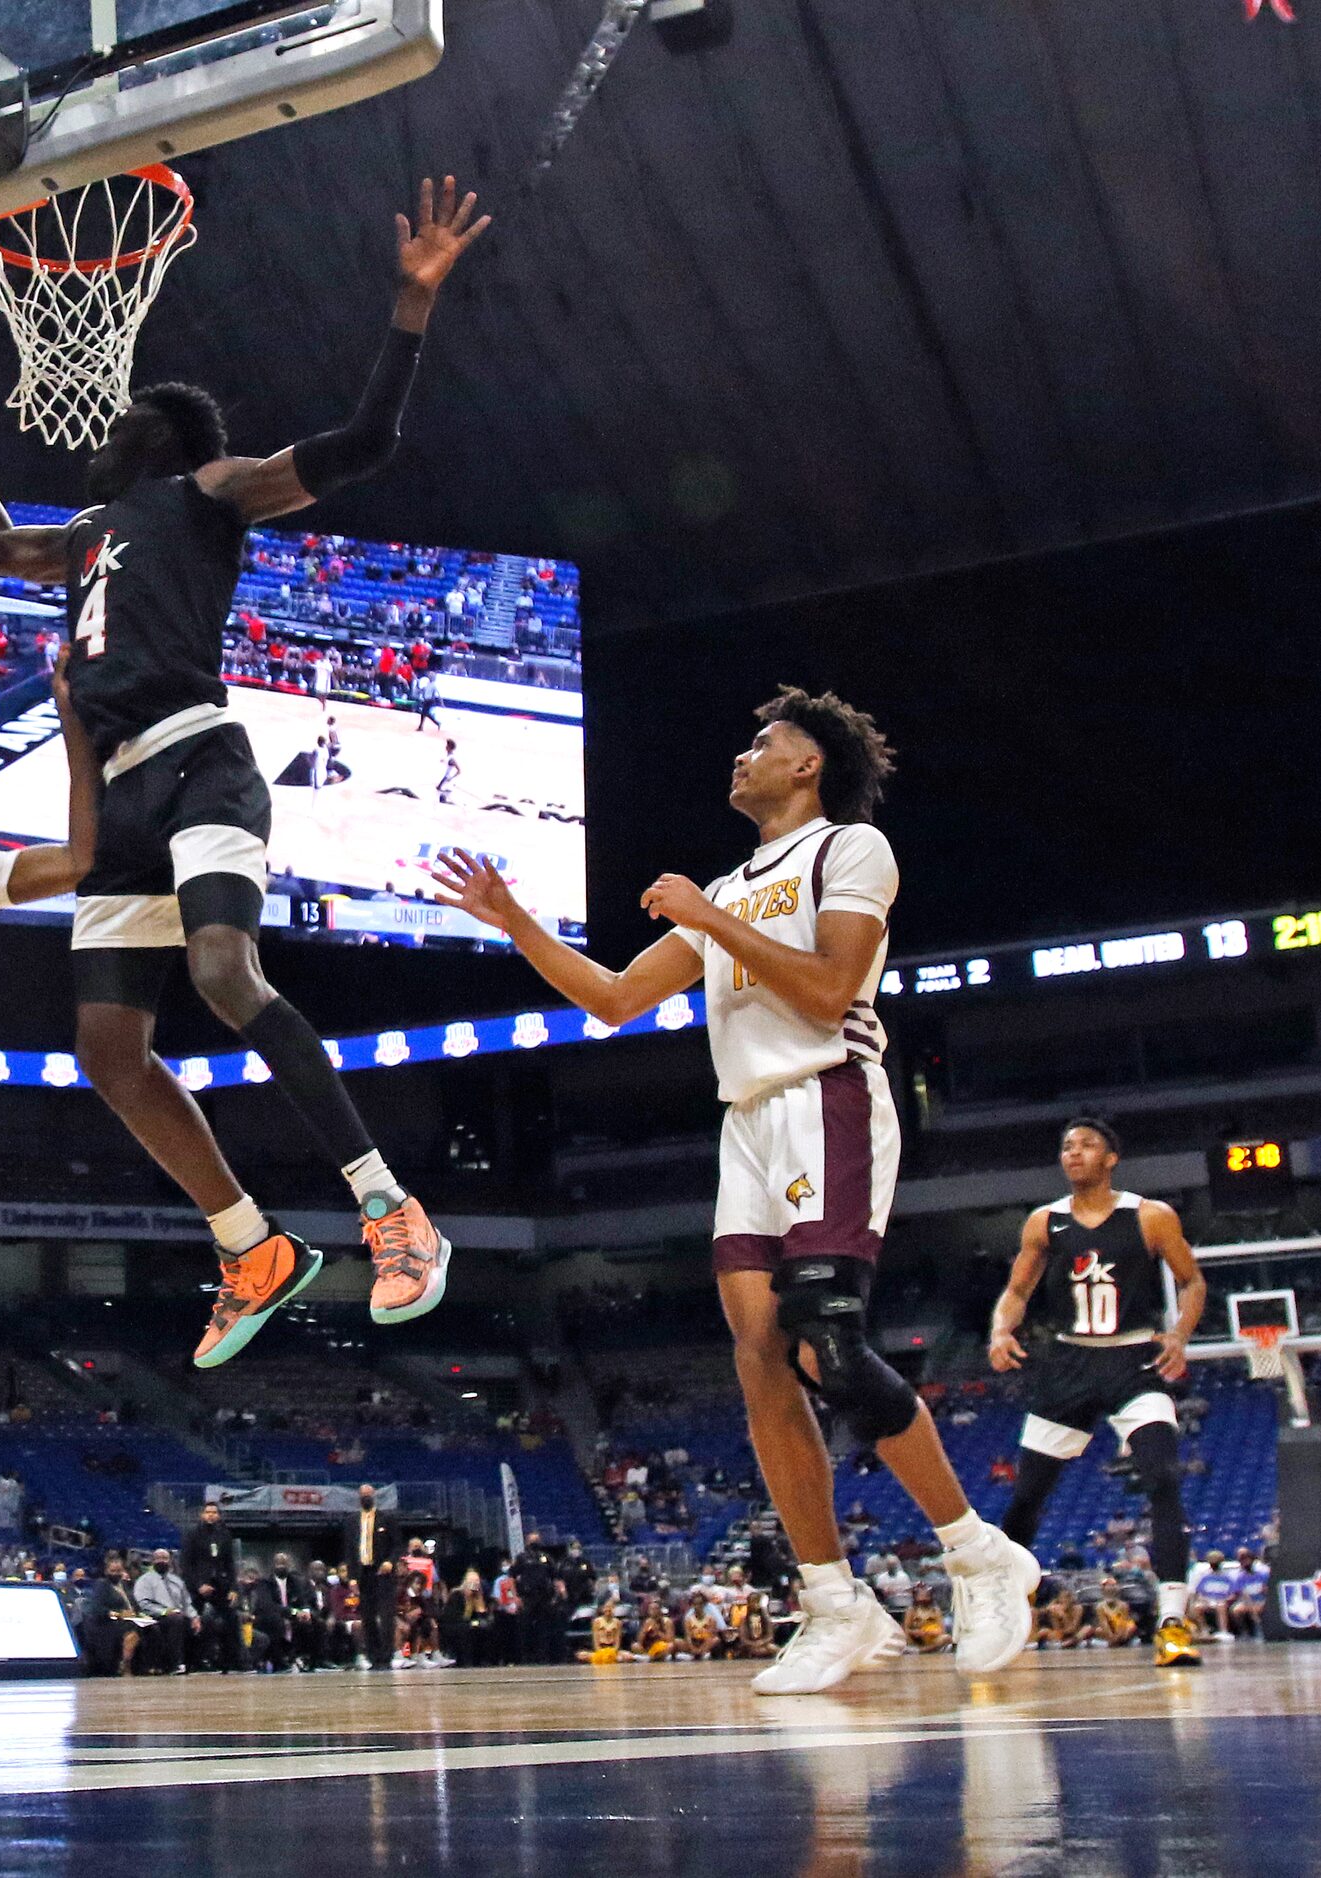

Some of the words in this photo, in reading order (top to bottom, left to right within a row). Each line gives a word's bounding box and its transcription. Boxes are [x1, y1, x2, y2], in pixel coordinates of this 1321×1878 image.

[75, 576, 110, 660] 4
[301, 902, 320, 924] 13
[394, 908, 443, 925] UNITED
[1202, 919, 1248, 960] 13
[966, 958, 991, 985] 2
[0, 1207, 88, 1231] University
[90, 1210, 148, 1229] Health
[1072, 1282, 1120, 1336] 10
